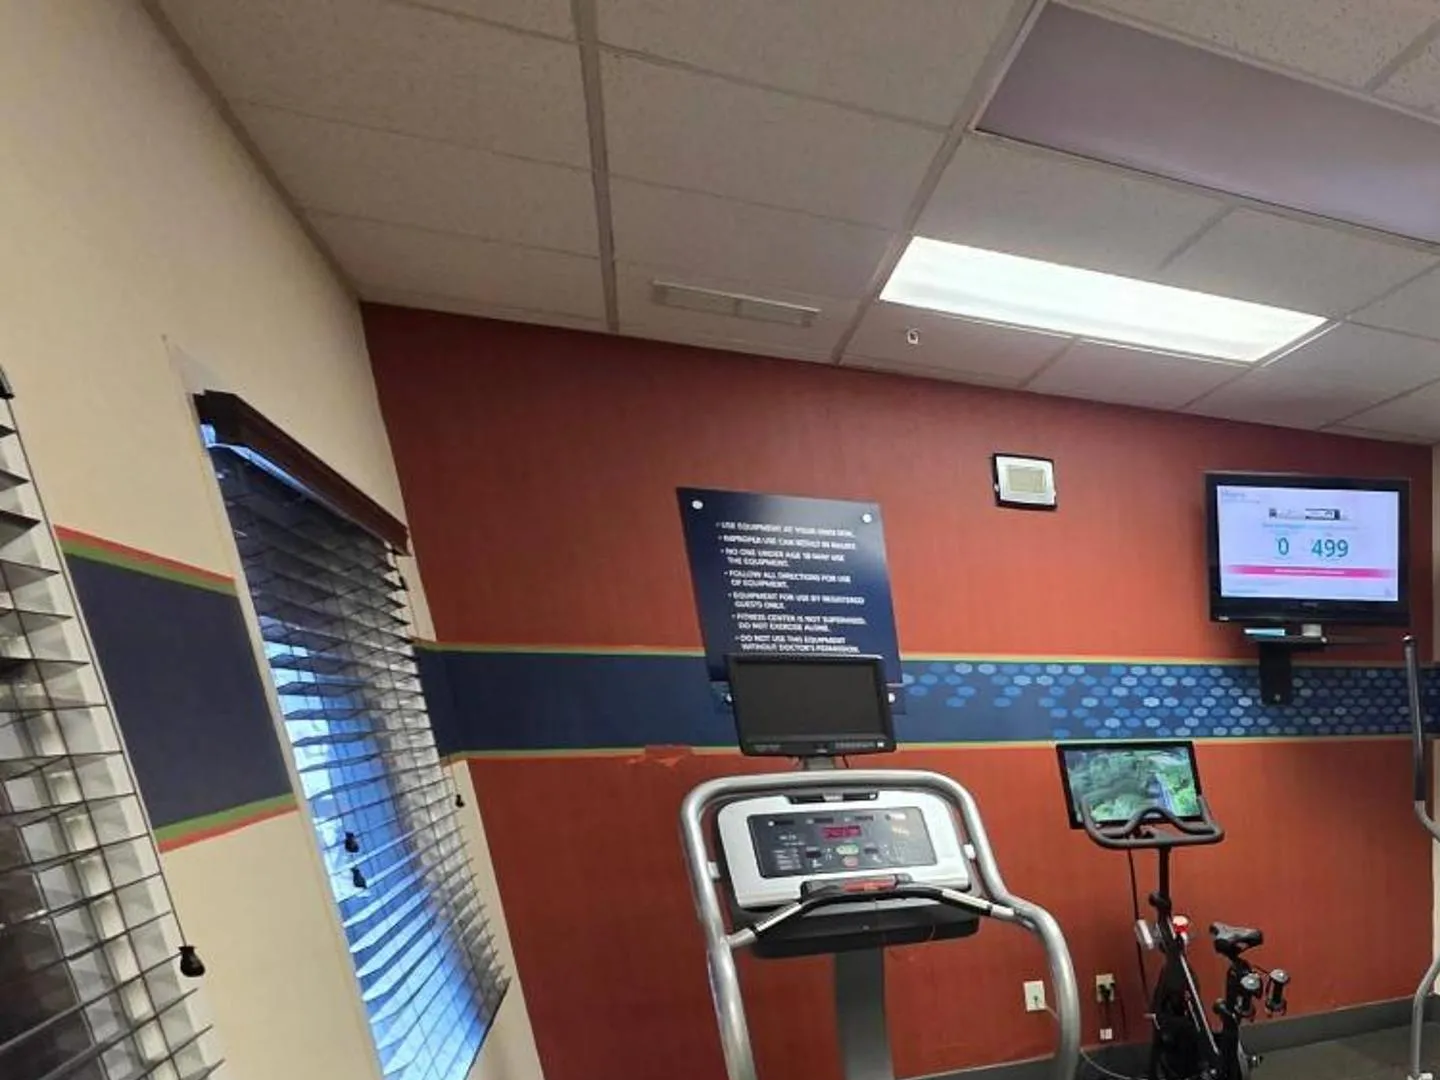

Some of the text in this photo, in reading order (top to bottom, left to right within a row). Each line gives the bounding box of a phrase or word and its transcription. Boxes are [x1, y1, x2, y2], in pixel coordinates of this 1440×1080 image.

[737, 522, 781, 532] EQUIPMENT
[1278, 537, 1349, 558] 0 499
[758, 550, 784, 558] UNDER
[727, 556, 742, 565] THE
[729, 570, 761, 578] FOLLOW
[777, 572, 820, 582] DIRECTIONS
[821, 575, 836, 583] FOR
[733, 592, 778, 600] EQUIPMENT
[779, 593, 795, 601] FOR
[735, 601, 763, 609] GUESTS
[736, 613, 767, 621] FITNESS
[767, 614, 796, 622] CENTER
[752, 622, 769, 630] NOT
[804, 636, 847, 644] EQUIPMENT
